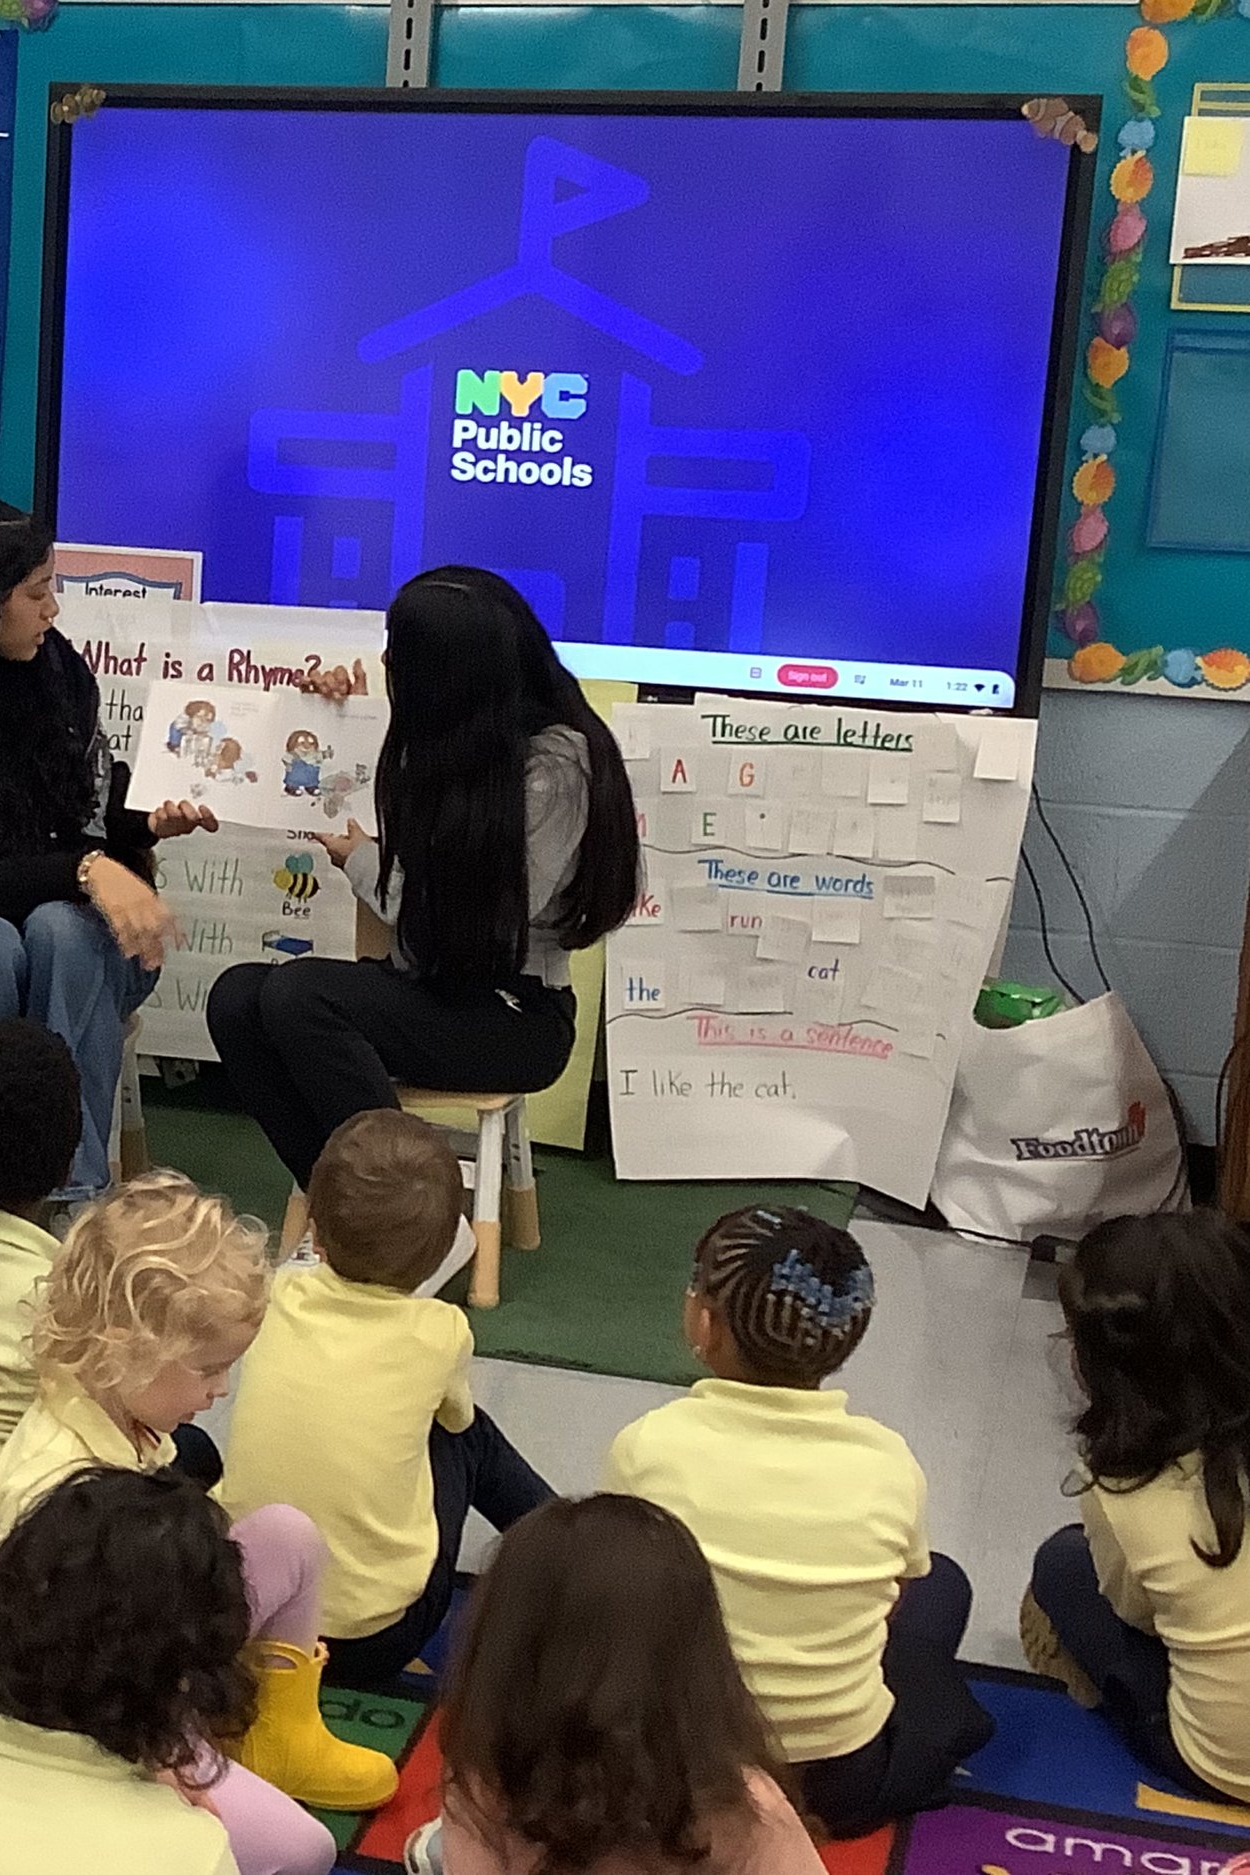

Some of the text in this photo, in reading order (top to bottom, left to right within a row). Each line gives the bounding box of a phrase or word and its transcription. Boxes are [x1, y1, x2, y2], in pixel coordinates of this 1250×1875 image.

[455, 369, 588, 420] NYC
[452, 419, 563, 453] Public
[451, 451, 593, 487] Schools
[85, 581, 147, 599] Interest
[75, 639, 322, 692] What is a Rhyme?
[889, 677, 924, 689] Mar 11
[946, 680, 968, 692] 1:22
[701, 713, 913, 750] These are letters
[671, 758, 687, 784] A
[738, 762, 755, 787] G
[702, 812, 717, 837] E
[184, 857, 243, 896] With
[697, 859, 874, 899] These are words
[282, 901, 311, 918] Bee
[730, 914, 763, 929] run
[808, 958, 840, 982] cat
[176, 978, 208, 1011] Wi
[625, 977, 661, 1003] the
[686, 1015, 894, 1054] This is a sentence
[618, 1069, 797, 1100] I like the cat.
[1005, 1827, 1222, 1875] amar
